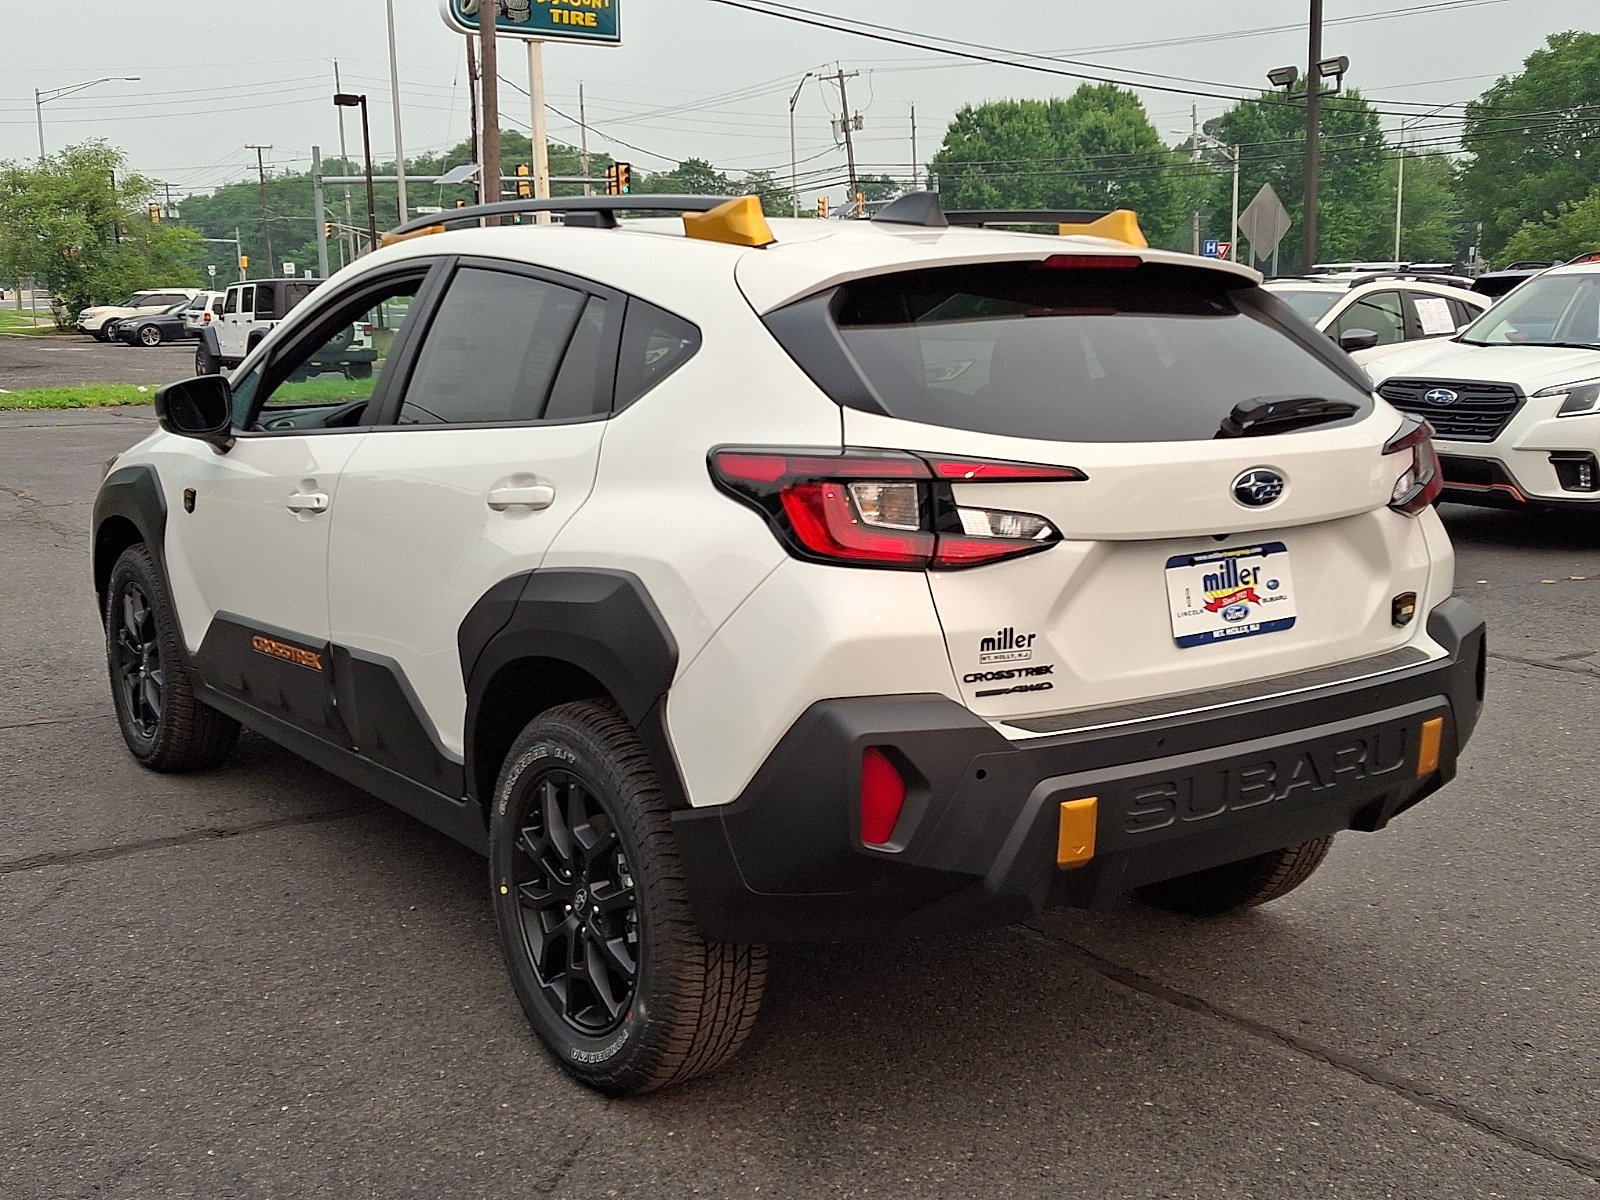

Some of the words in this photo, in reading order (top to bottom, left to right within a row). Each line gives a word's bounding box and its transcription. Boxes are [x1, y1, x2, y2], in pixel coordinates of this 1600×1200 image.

[549, 8, 598, 27] TIRE
[1206, 242, 1216, 253] H
[1203, 558, 1260, 592] miller
[980, 627, 1036, 651] miller
[963, 664, 1054, 683] CROSSTREK
[1010, 682, 1054, 693] AWD
[1126, 728, 1408, 834] SUBARU
